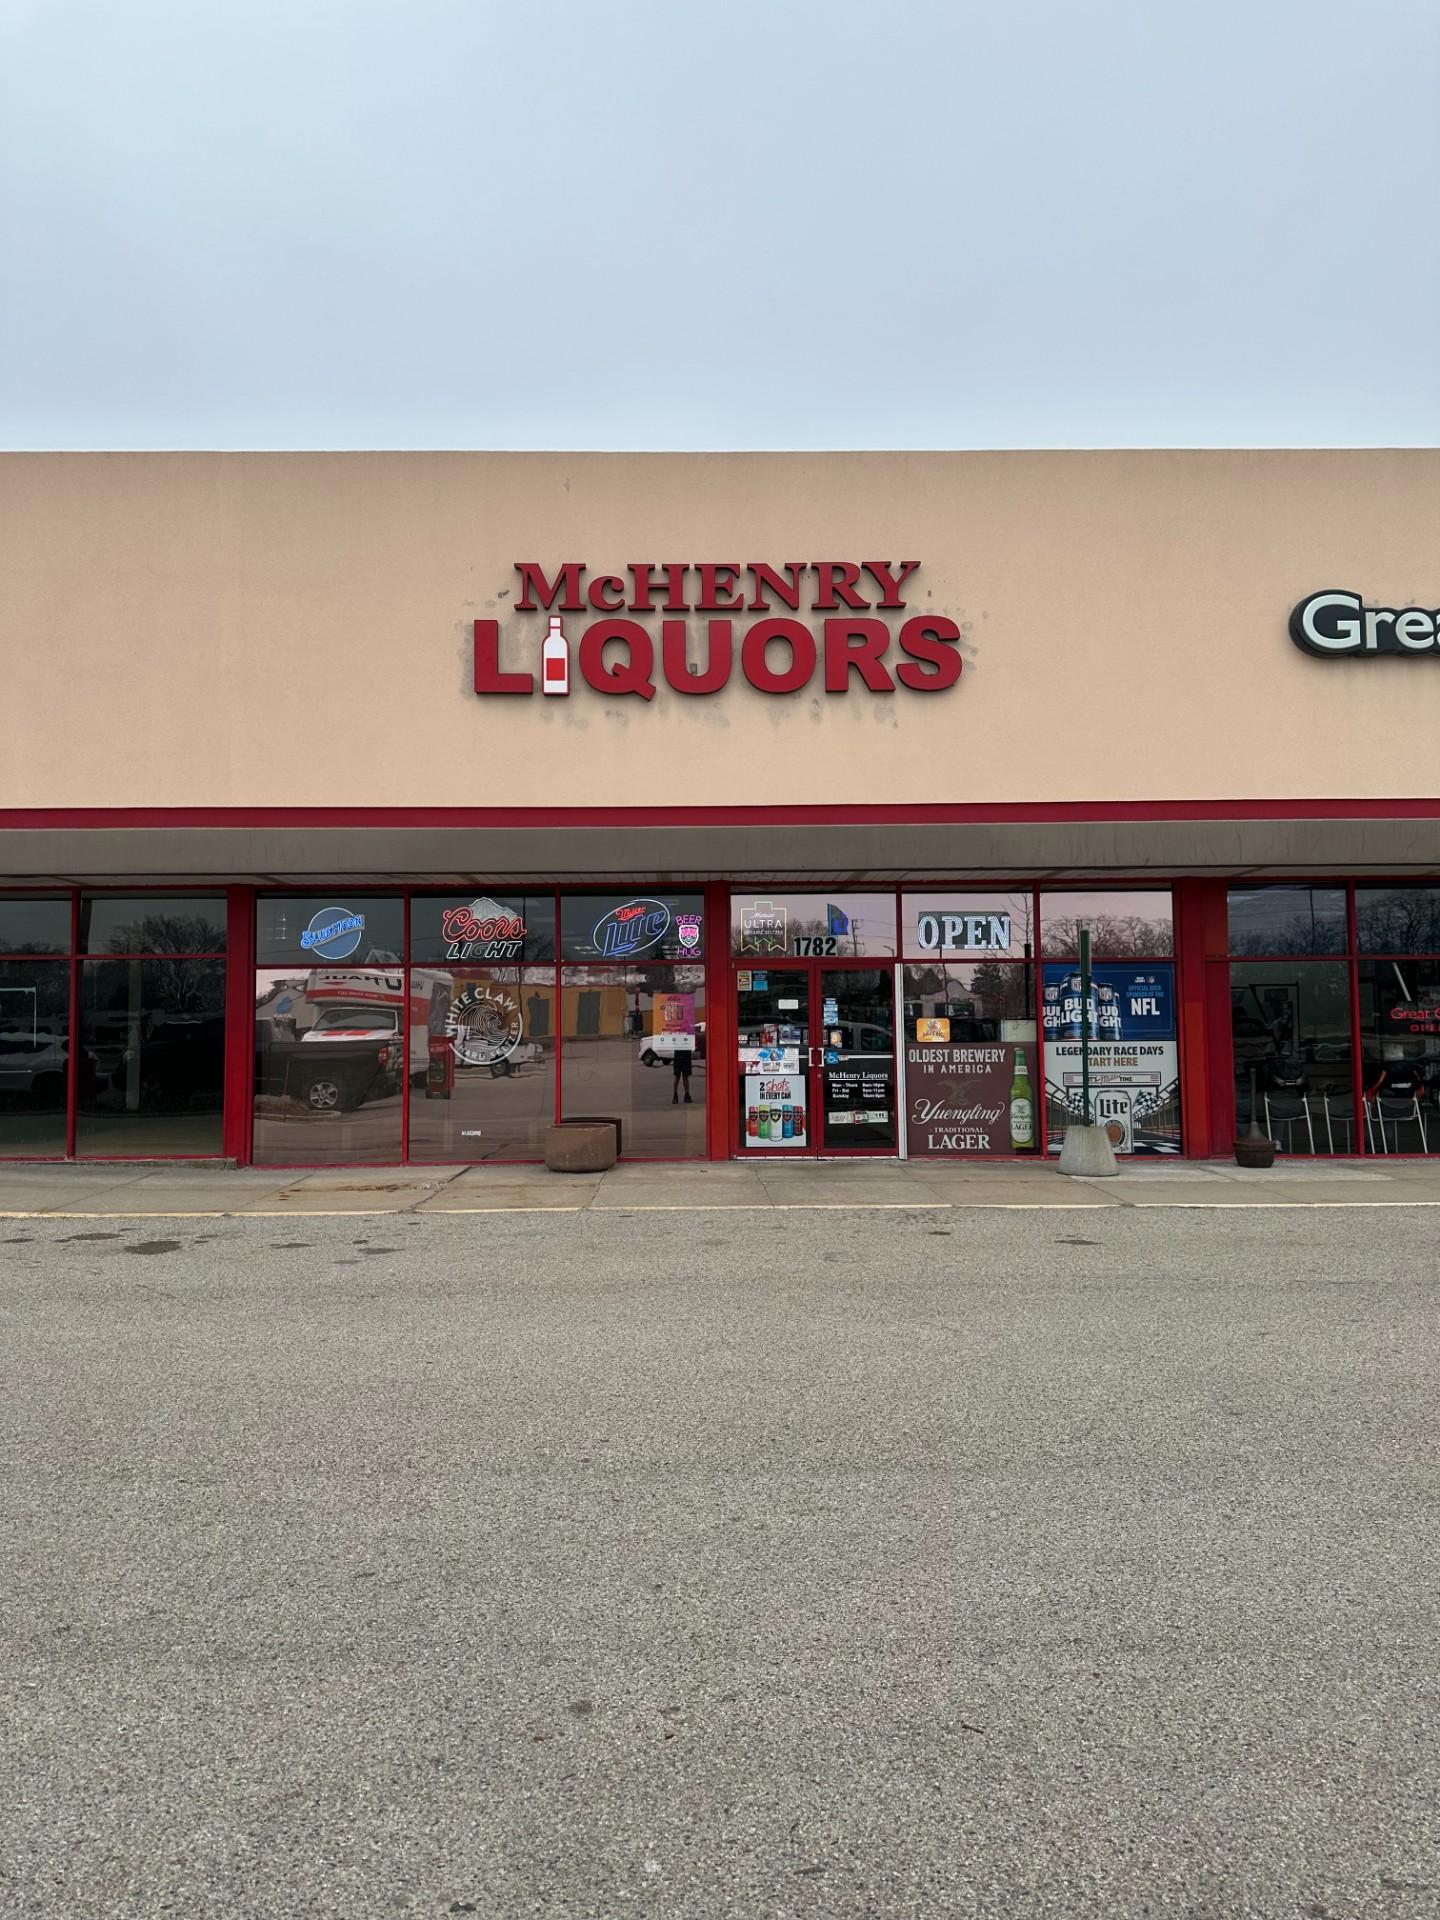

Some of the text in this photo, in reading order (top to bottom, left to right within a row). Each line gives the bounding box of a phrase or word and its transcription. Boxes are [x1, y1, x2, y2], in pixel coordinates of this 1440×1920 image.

[513, 561, 922, 612] McHENRY
[1302, 594, 1440, 649] Gre
[442, 907, 528, 943] Coors
[675, 915, 702, 926] BEER
[744, 919, 783, 929] ULTRA
[918, 915, 1011, 951] OPEN
[447, 941, 522, 959] LIGHT
[677, 946, 702, 956] HUG
[794, 937, 836, 956] 1782
[444, 987, 518, 1037] WHITE CLAW
[1131, 998, 1160, 1015] NFL
[909, 1049, 1006, 1063] OLDEST BREWERY
[1114, 1046, 1138, 1055] RACE
[1140, 1046, 1164, 1056] DAYS
[923, 1064, 992, 1074] IN AMERICA
[1088, 1057, 1138, 1067] TART HERE
[829, 1071, 888, 1081] McHenry Liquors
[760, 1081, 765, 1091] 2
[912, 1098, 1005, 1125] Yuengling
[1099, 1099, 1128, 1118] Lite
[928, 1134, 991, 1150] LAGER
